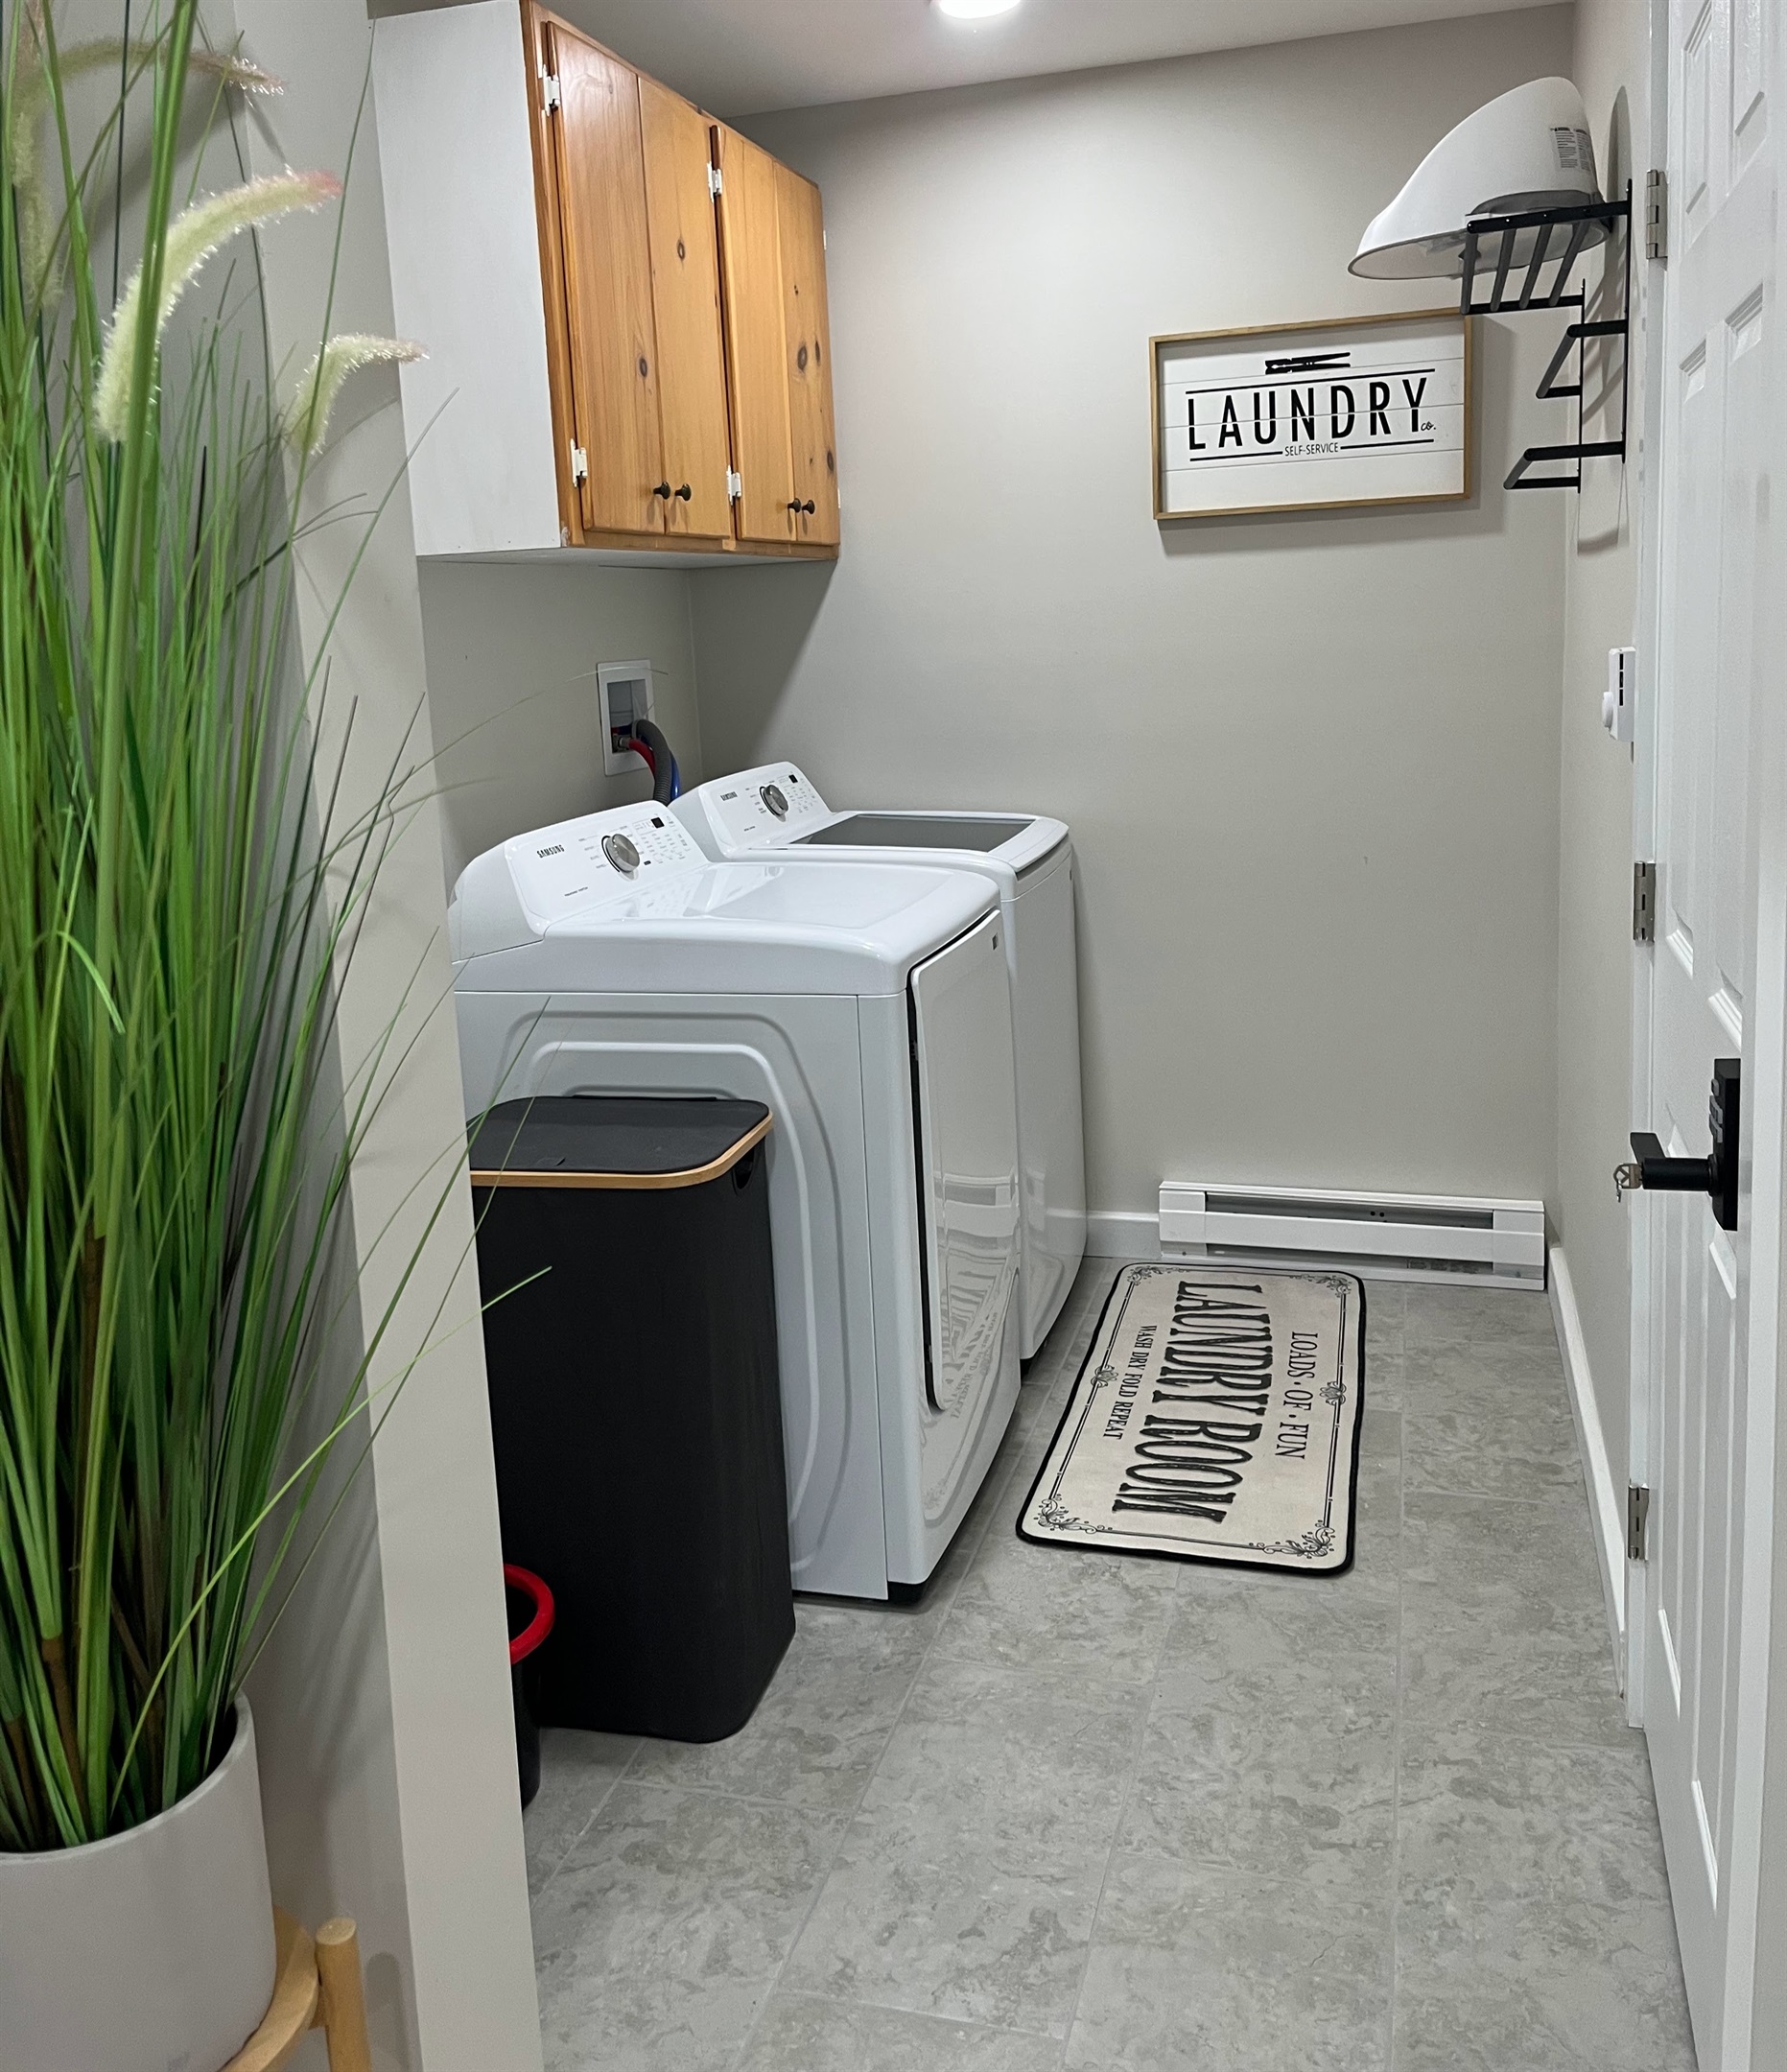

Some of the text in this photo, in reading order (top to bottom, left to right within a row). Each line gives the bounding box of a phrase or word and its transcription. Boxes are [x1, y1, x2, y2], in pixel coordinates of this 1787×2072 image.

[1188, 377, 1426, 450] LAUNDRY
[1285, 442, 1339, 457] SELF-SERVICE
[537, 844, 565, 859] SAMSUNG
[1103, 1326, 1157, 1440] WASH DRY FOLD REPEAT
[1112, 1281, 1273, 1523] LAUNDRY ROOM
[1275, 1331, 1318, 1459] LOADS OF FUN
